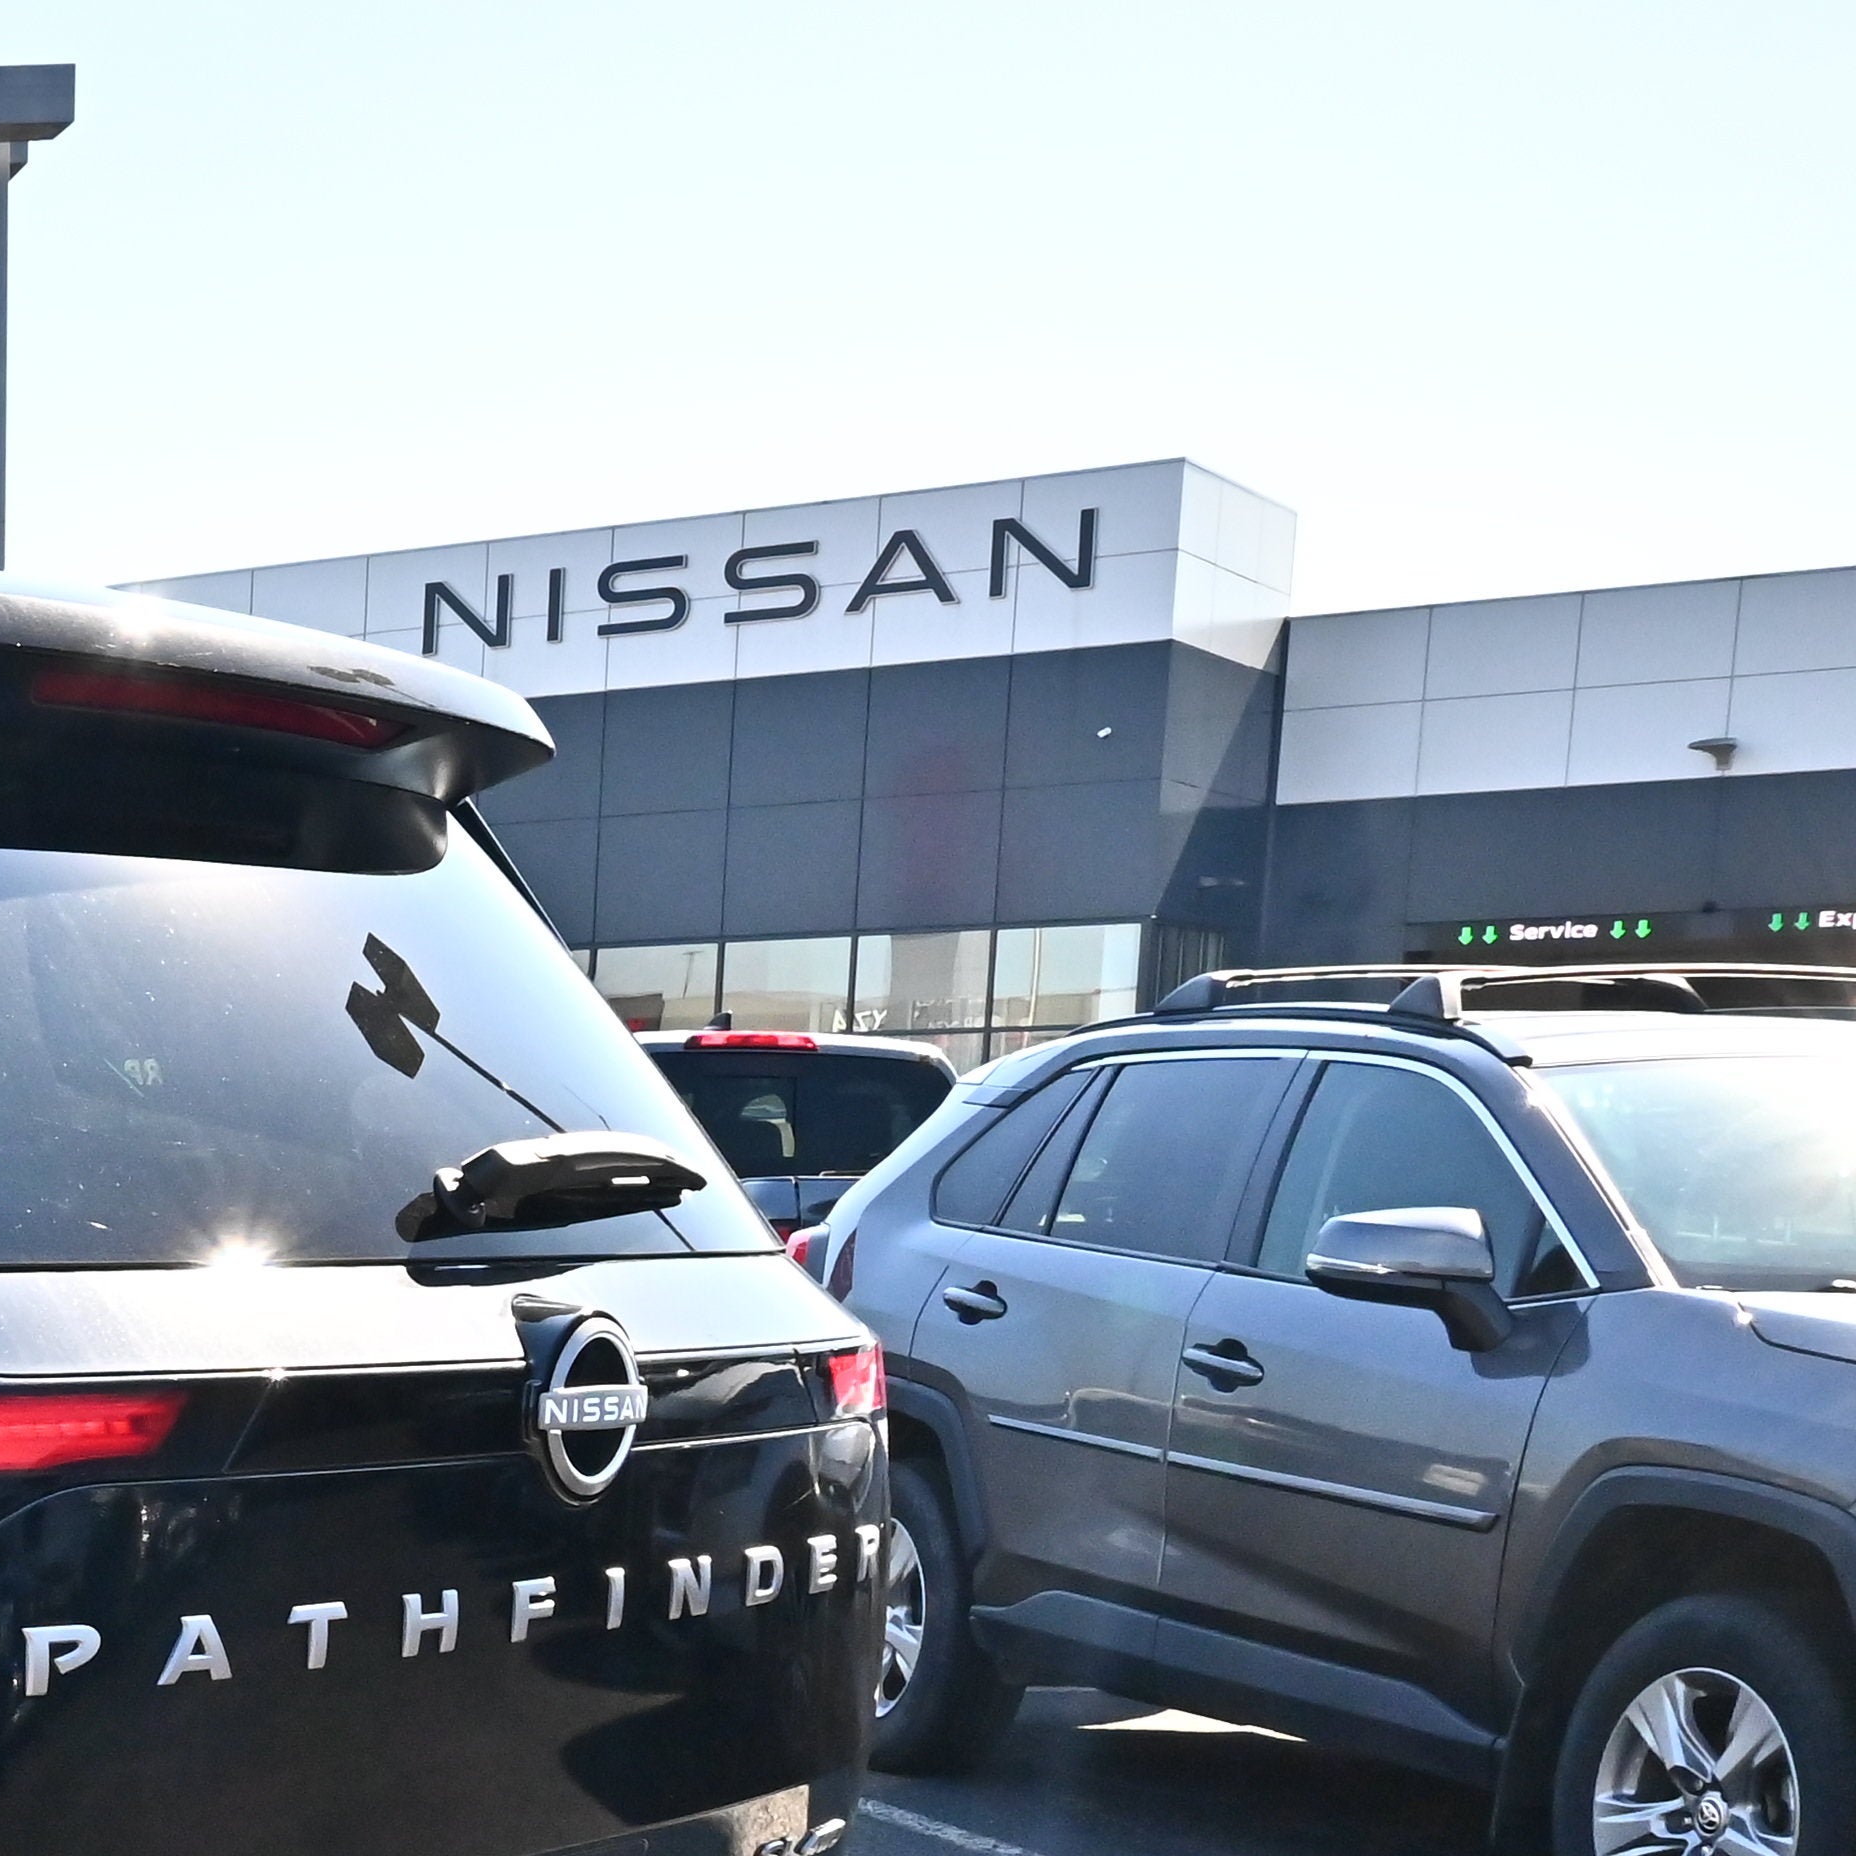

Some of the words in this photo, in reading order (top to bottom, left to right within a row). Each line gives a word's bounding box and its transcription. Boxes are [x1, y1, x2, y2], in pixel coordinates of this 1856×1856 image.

[422, 507, 1098, 655] NISSAN
[1509, 921, 1598, 940] Service
[1819, 910, 1856, 930] Ex
[544, 1395, 646, 1424] NISSAN
[24, 1523, 880, 1697] PATHFINDER
